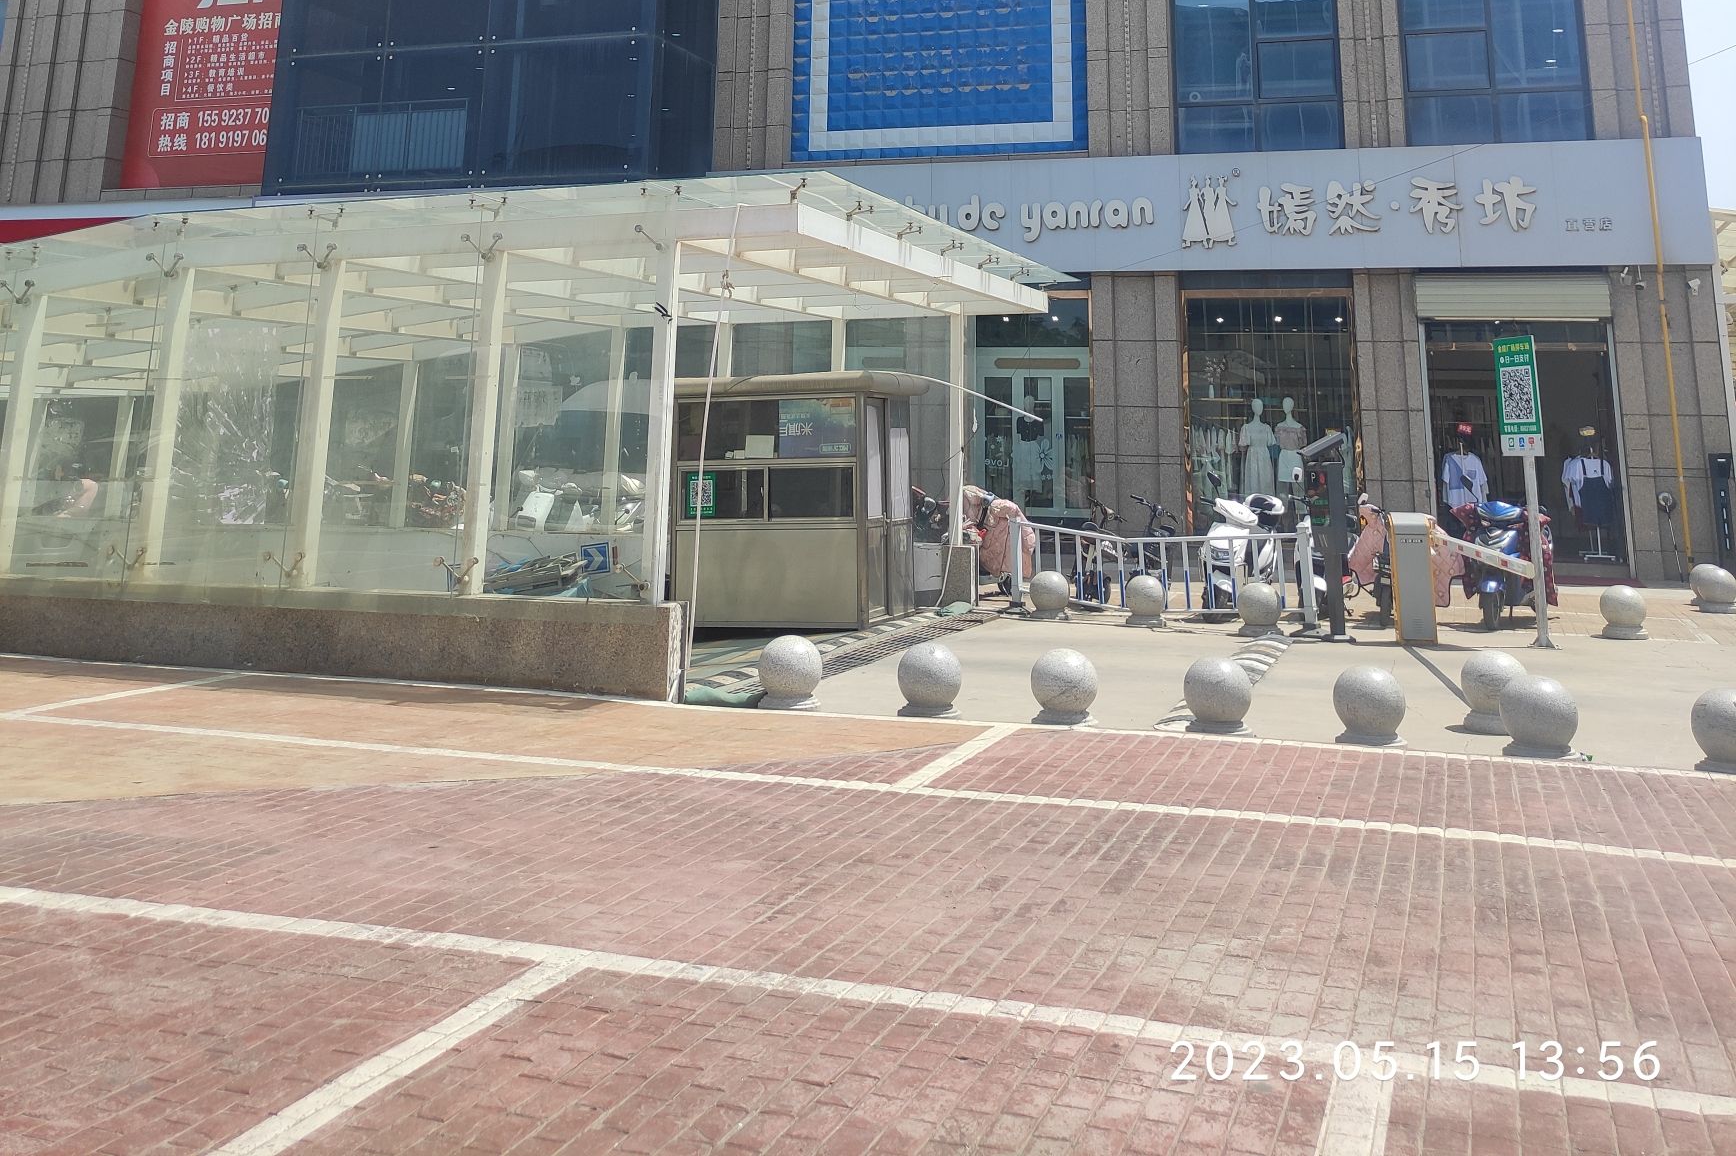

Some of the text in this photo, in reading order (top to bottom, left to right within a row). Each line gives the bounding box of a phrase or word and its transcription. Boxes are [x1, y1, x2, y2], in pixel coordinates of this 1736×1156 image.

[160, 41, 177, 96] 招商项目
[160, 112, 190, 130] 招商
[157, 133, 187, 152] 热线
[1020, 197, 1154, 243] yanran
